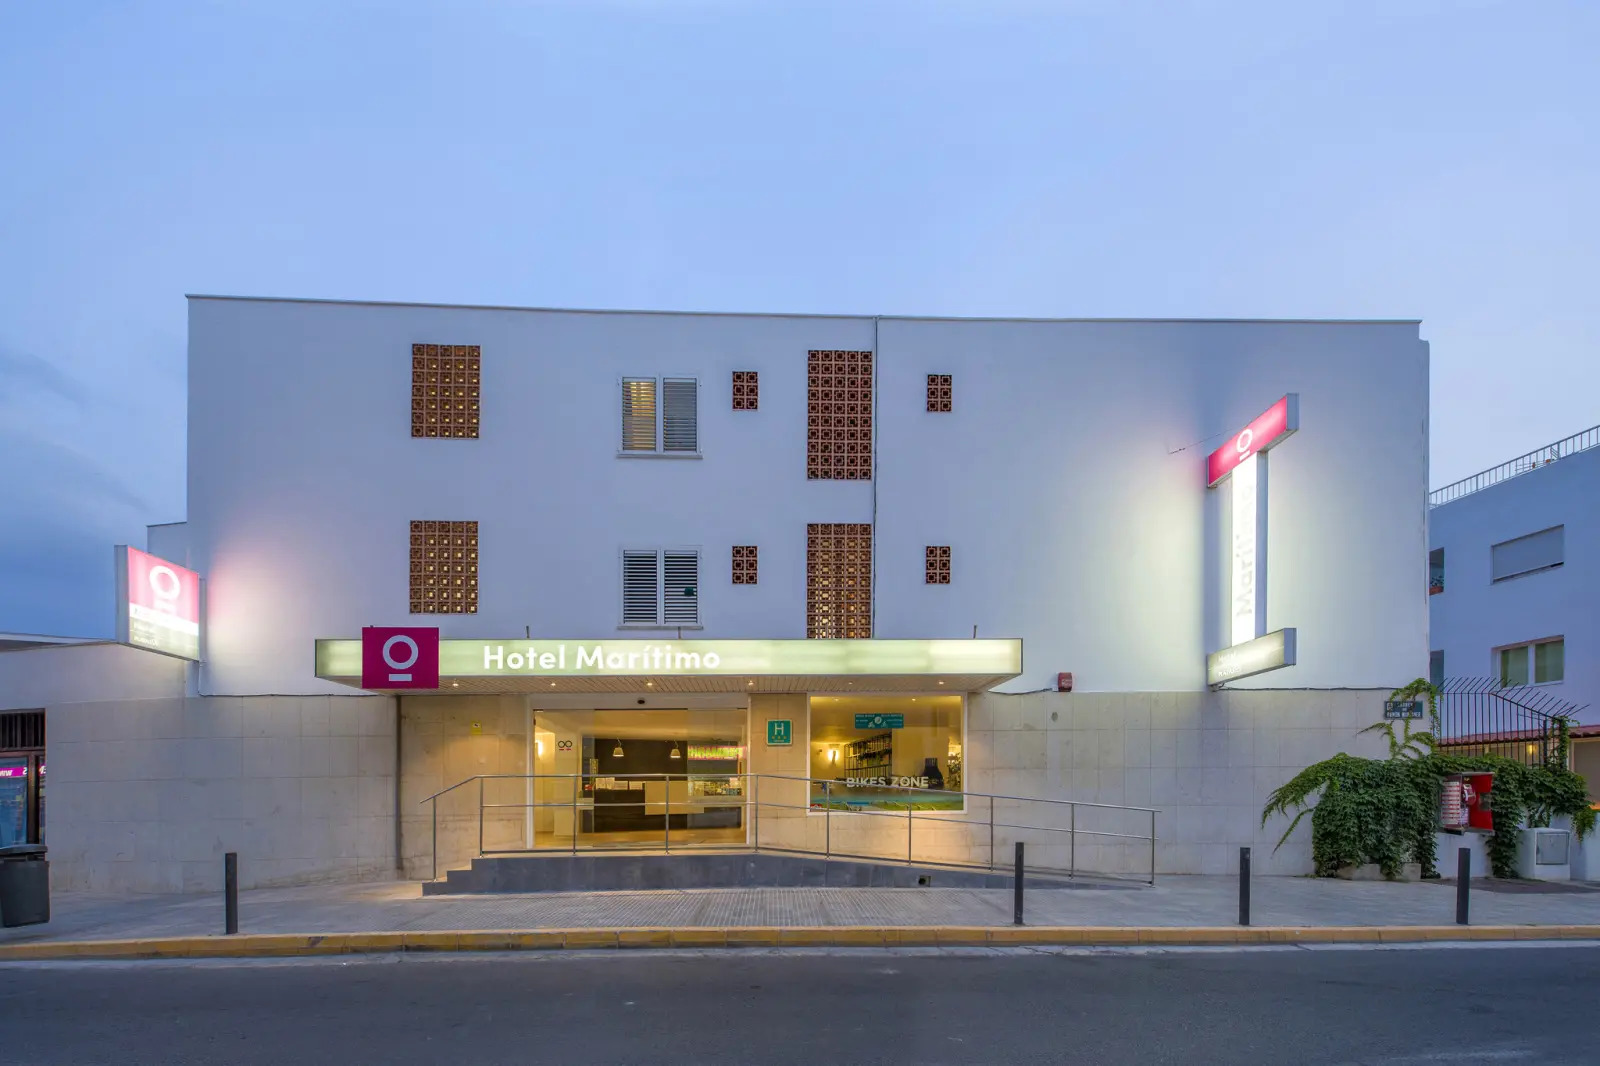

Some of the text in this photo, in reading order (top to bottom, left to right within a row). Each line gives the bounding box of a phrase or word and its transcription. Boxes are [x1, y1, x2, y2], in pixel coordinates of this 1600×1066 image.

[483, 645, 720, 669] Hotel Marítimo
[775, 722, 784, 735] H
[846, 776, 929, 788] BIKES ZONE
